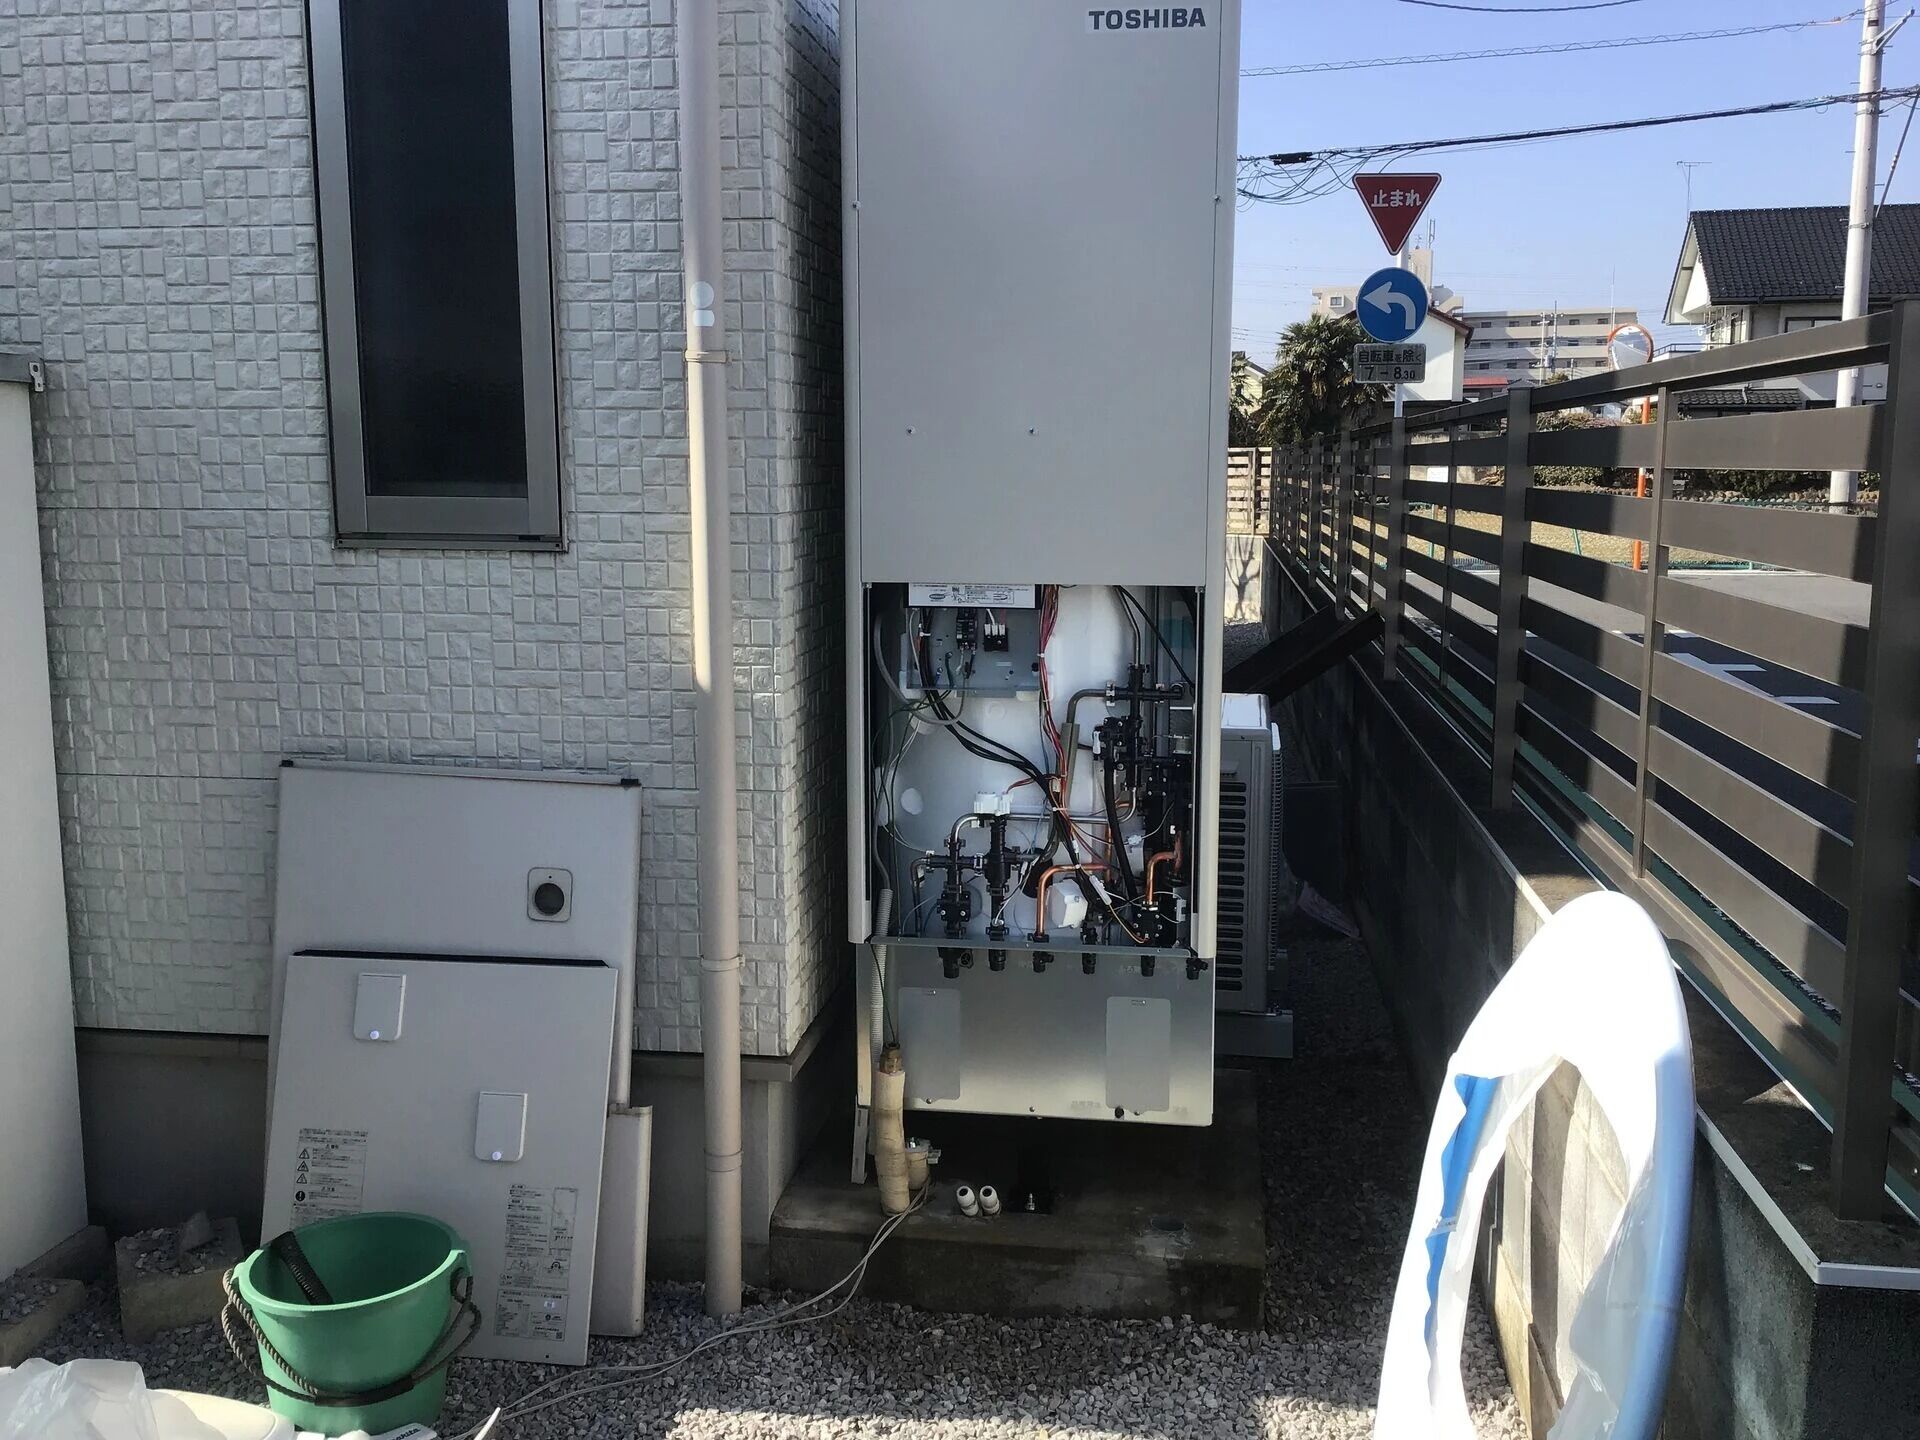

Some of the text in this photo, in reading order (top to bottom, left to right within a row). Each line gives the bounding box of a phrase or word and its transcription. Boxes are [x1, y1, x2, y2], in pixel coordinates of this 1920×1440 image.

[1088, 7, 1207, 30] TOSHIBA
[1371, 189, 1421, 207] 止まれ
[1359, 349, 1422, 363] 自転車を除く
[392, 1428, 421, 1440] akita
